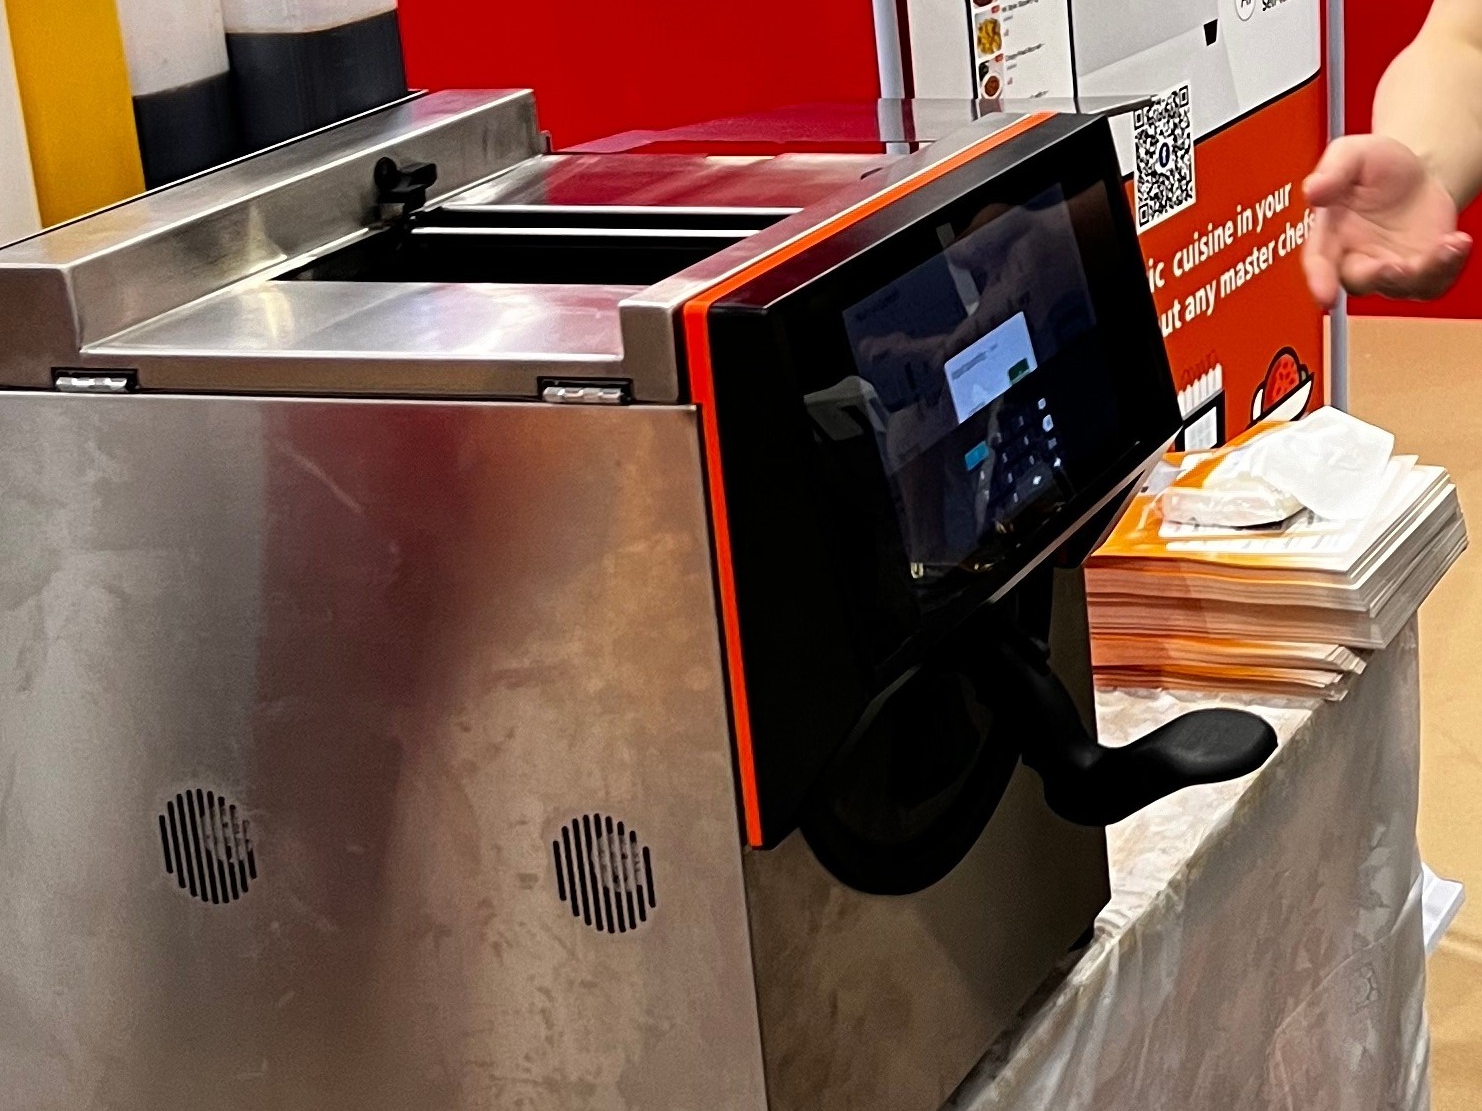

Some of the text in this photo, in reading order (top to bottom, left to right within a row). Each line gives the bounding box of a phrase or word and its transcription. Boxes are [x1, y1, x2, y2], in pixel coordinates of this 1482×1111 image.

[1147, 182, 1292, 294] ic cuisine in your
[1159, 298, 1182, 338] ut
[1185, 279, 1217, 322] any
[1220, 240, 1276, 299] master
